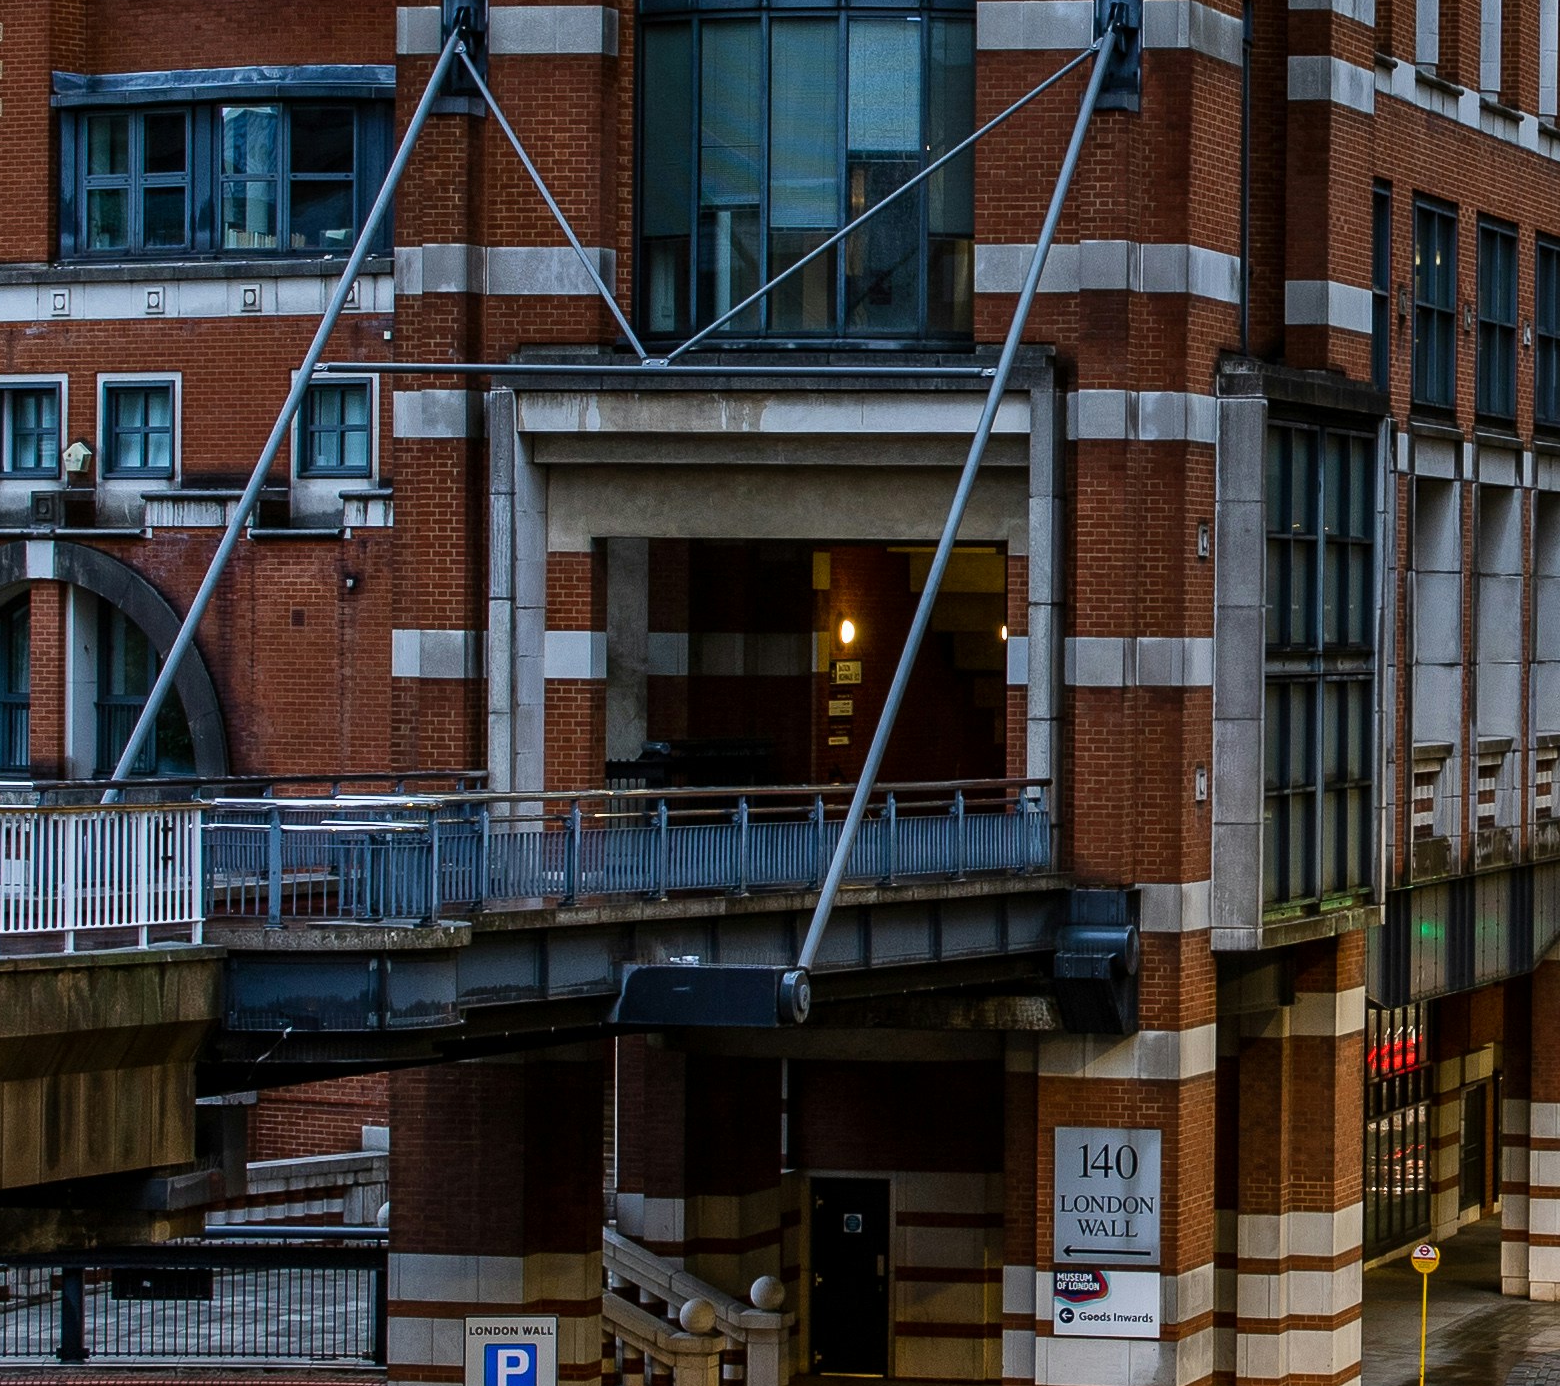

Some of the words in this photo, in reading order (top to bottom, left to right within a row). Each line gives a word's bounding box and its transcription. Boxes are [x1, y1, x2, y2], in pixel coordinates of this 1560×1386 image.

[1078, 1144, 1138, 1180] 140
[1060, 1195, 1155, 1215] LONDON
[1076, 1219, 1139, 1238] WALL
[1056, 1273, 1093, 1281] MUSEUM
[1056, 1282, 1067, 1290] OF
[1069, 1282, 1100, 1290] LONDON
[1079, 1311, 1112, 1321] Goods
[1113, 1313, 1154, 1323] Inwards
[469, 1326, 519, 1336] LONDON
[521, 1326, 554, 1336] WALL
